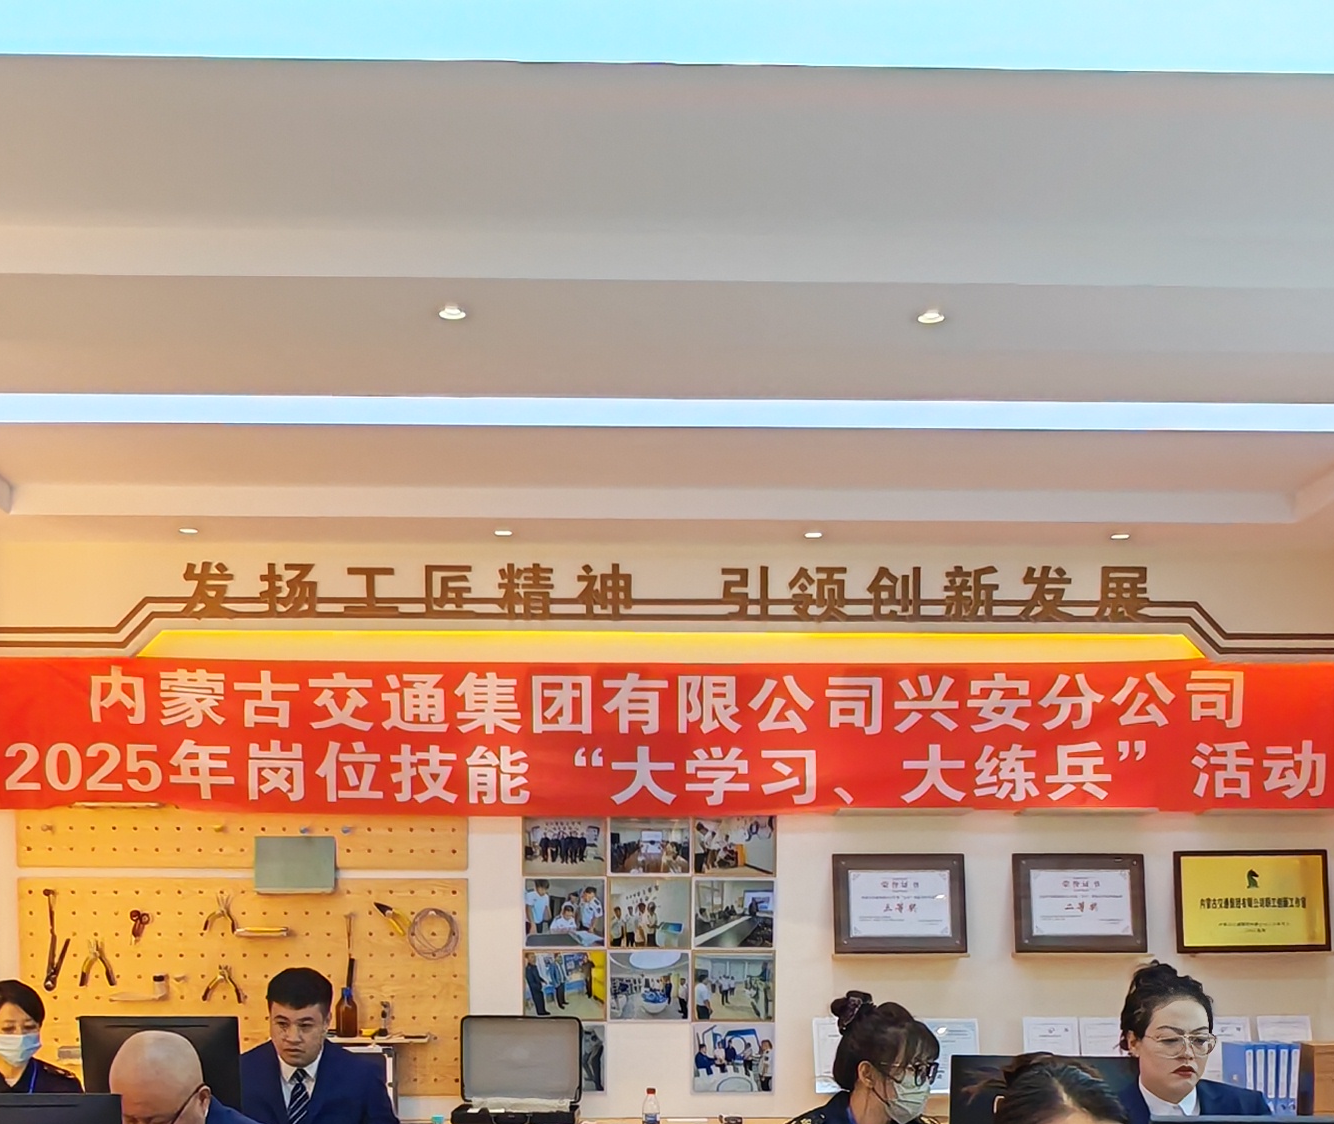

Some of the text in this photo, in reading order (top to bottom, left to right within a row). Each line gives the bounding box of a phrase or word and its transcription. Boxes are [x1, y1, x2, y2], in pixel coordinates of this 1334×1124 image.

[183, 561, 1150, 622] 发扬工匠精神 引领创新发展
[89, 666, 1245, 736] 内蒙古交通集团有限公司兴安分公司
